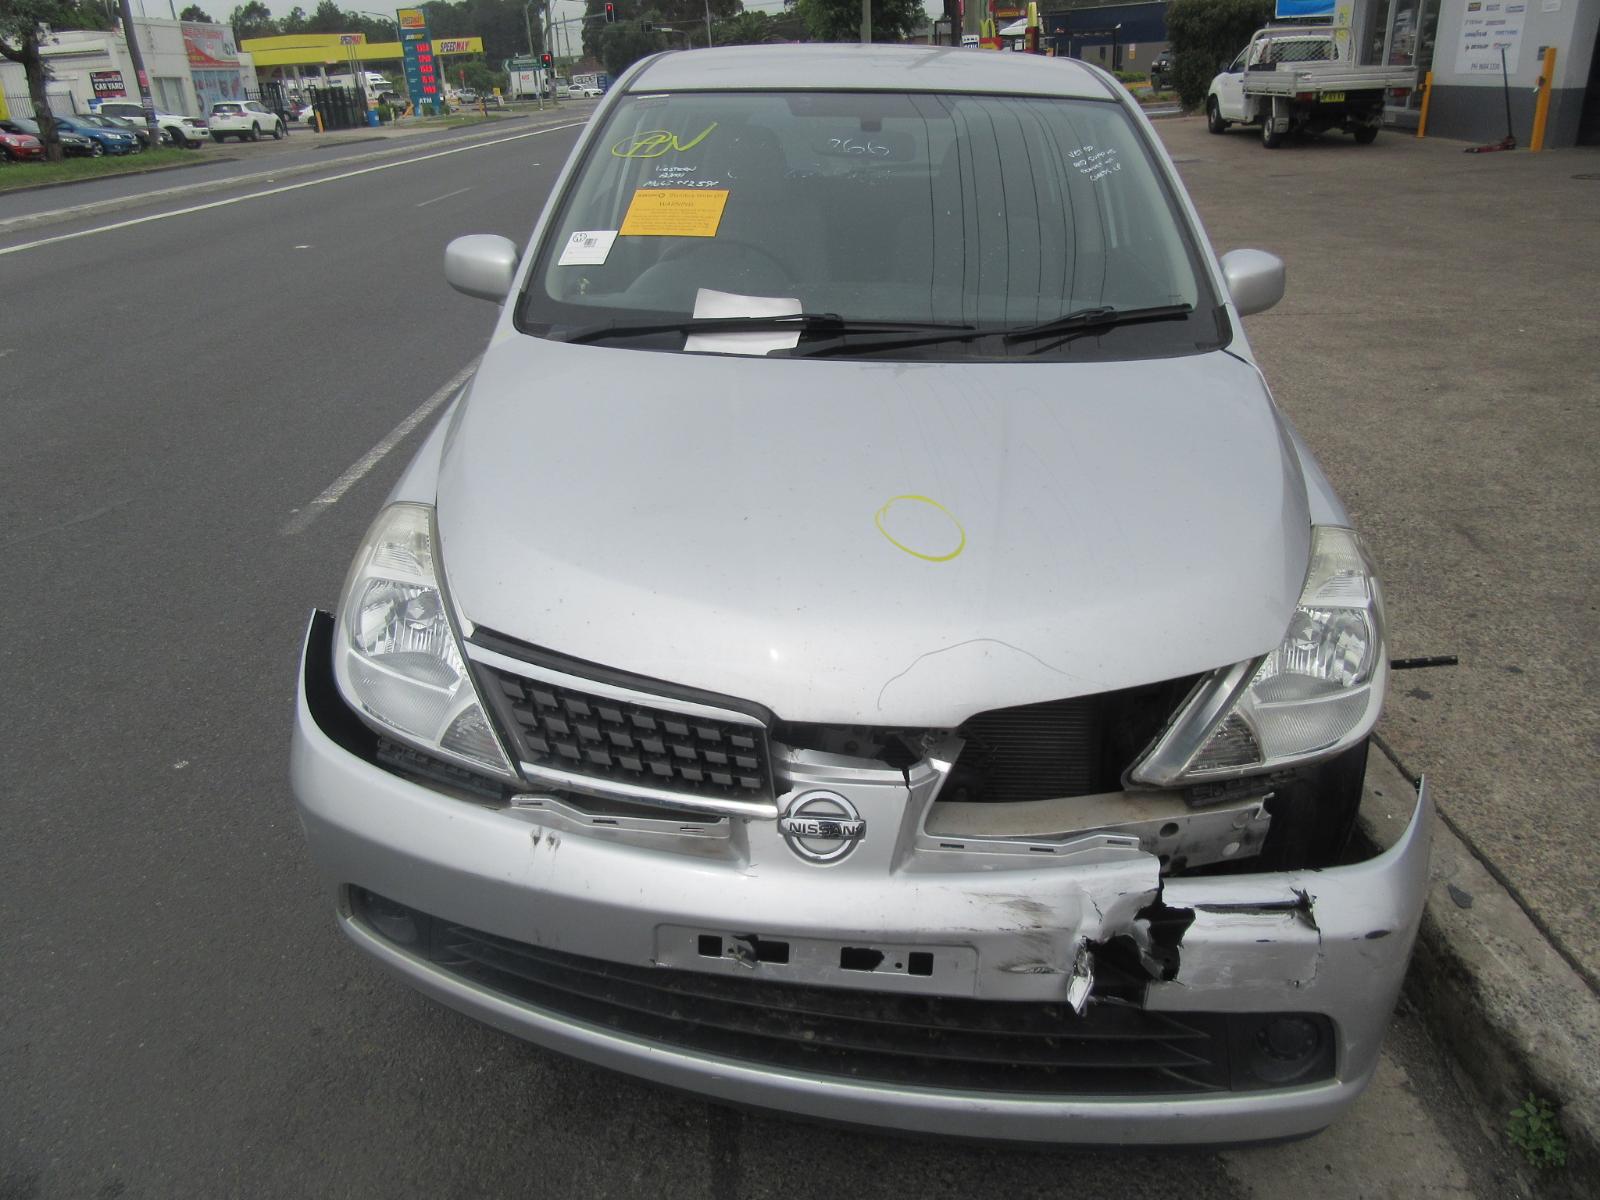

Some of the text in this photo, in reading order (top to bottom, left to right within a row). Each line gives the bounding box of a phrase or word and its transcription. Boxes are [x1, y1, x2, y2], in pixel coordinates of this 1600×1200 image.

[440, 40, 470, 53] SPEEDWAY
[95, 82, 124, 91] CAR YARD
[789, 822, 856, 835] NISSAN
